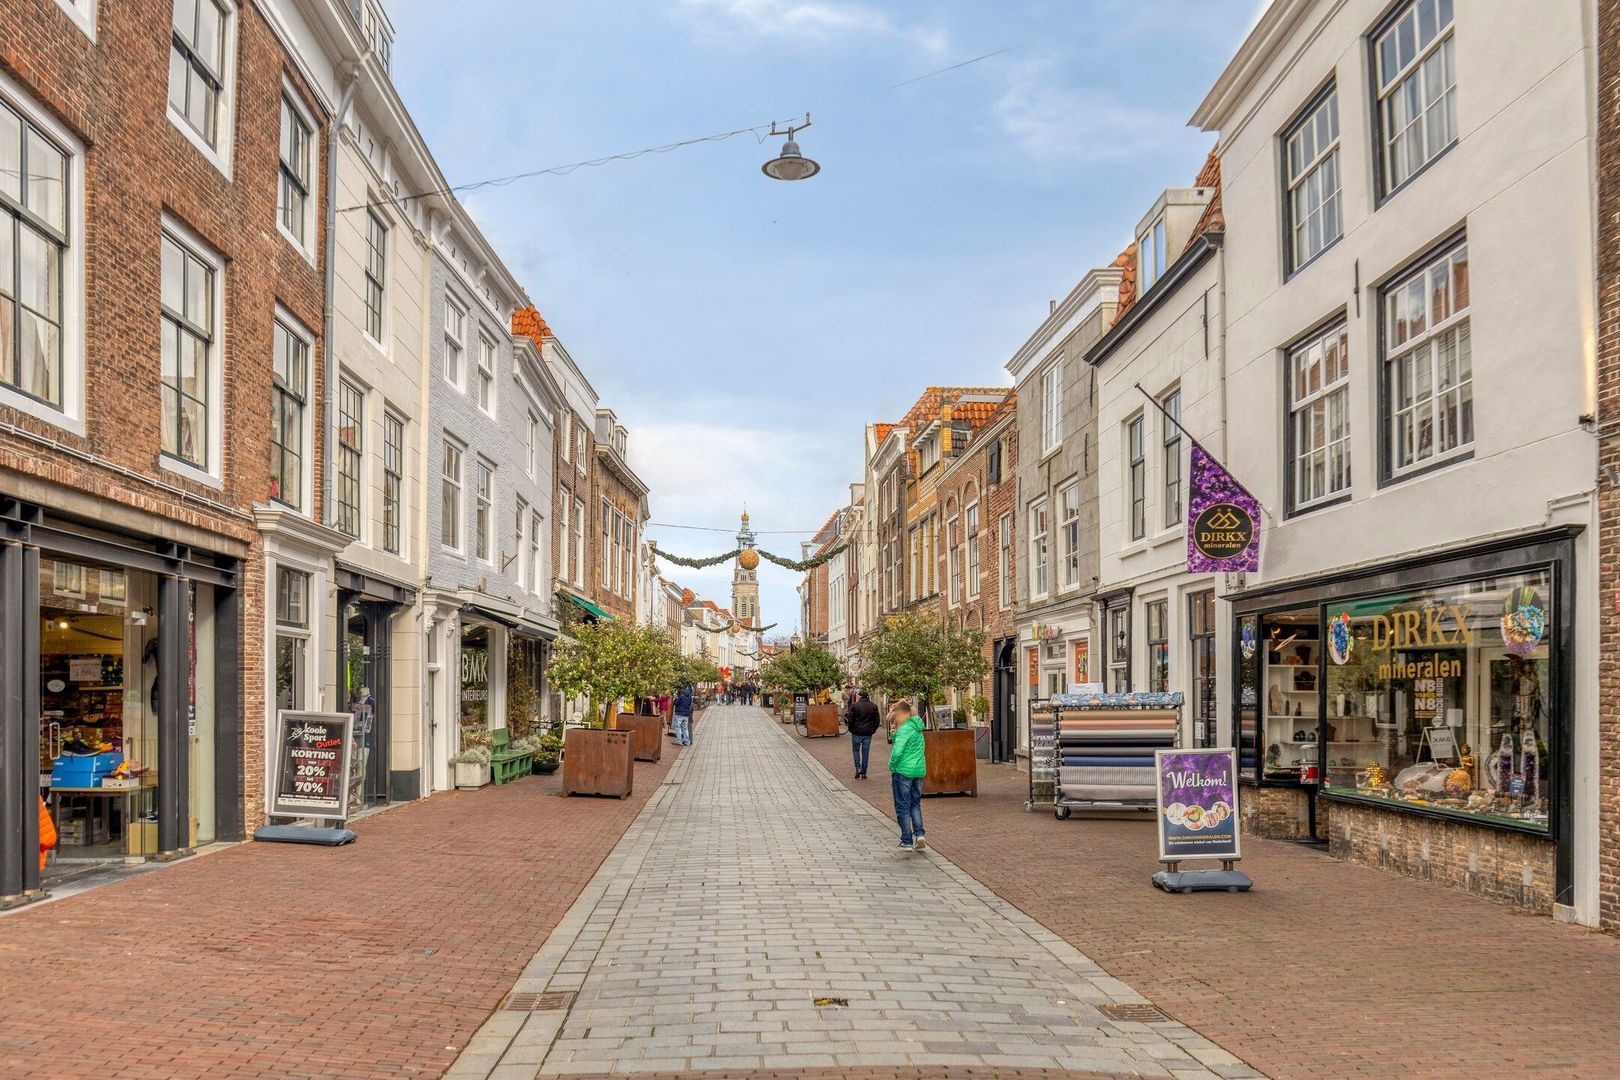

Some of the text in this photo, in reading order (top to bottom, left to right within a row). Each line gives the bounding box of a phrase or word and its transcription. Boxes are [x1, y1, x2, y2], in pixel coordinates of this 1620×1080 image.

[1200, 531, 1247, 542] DIRKX
[1371, 603, 1473, 651] DIRKX
[462, 653, 488, 682] BMK
[1379, 653, 1461, 679] mineralen
[303, 733, 327, 743] Sport
[316, 738, 341, 749] Outlet
[291, 749, 336, 760] KORTING
[296, 765, 325, 776] 20%
[1166, 770, 1227, 789] Welkom!
[295, 781, 324, 793] 70%
